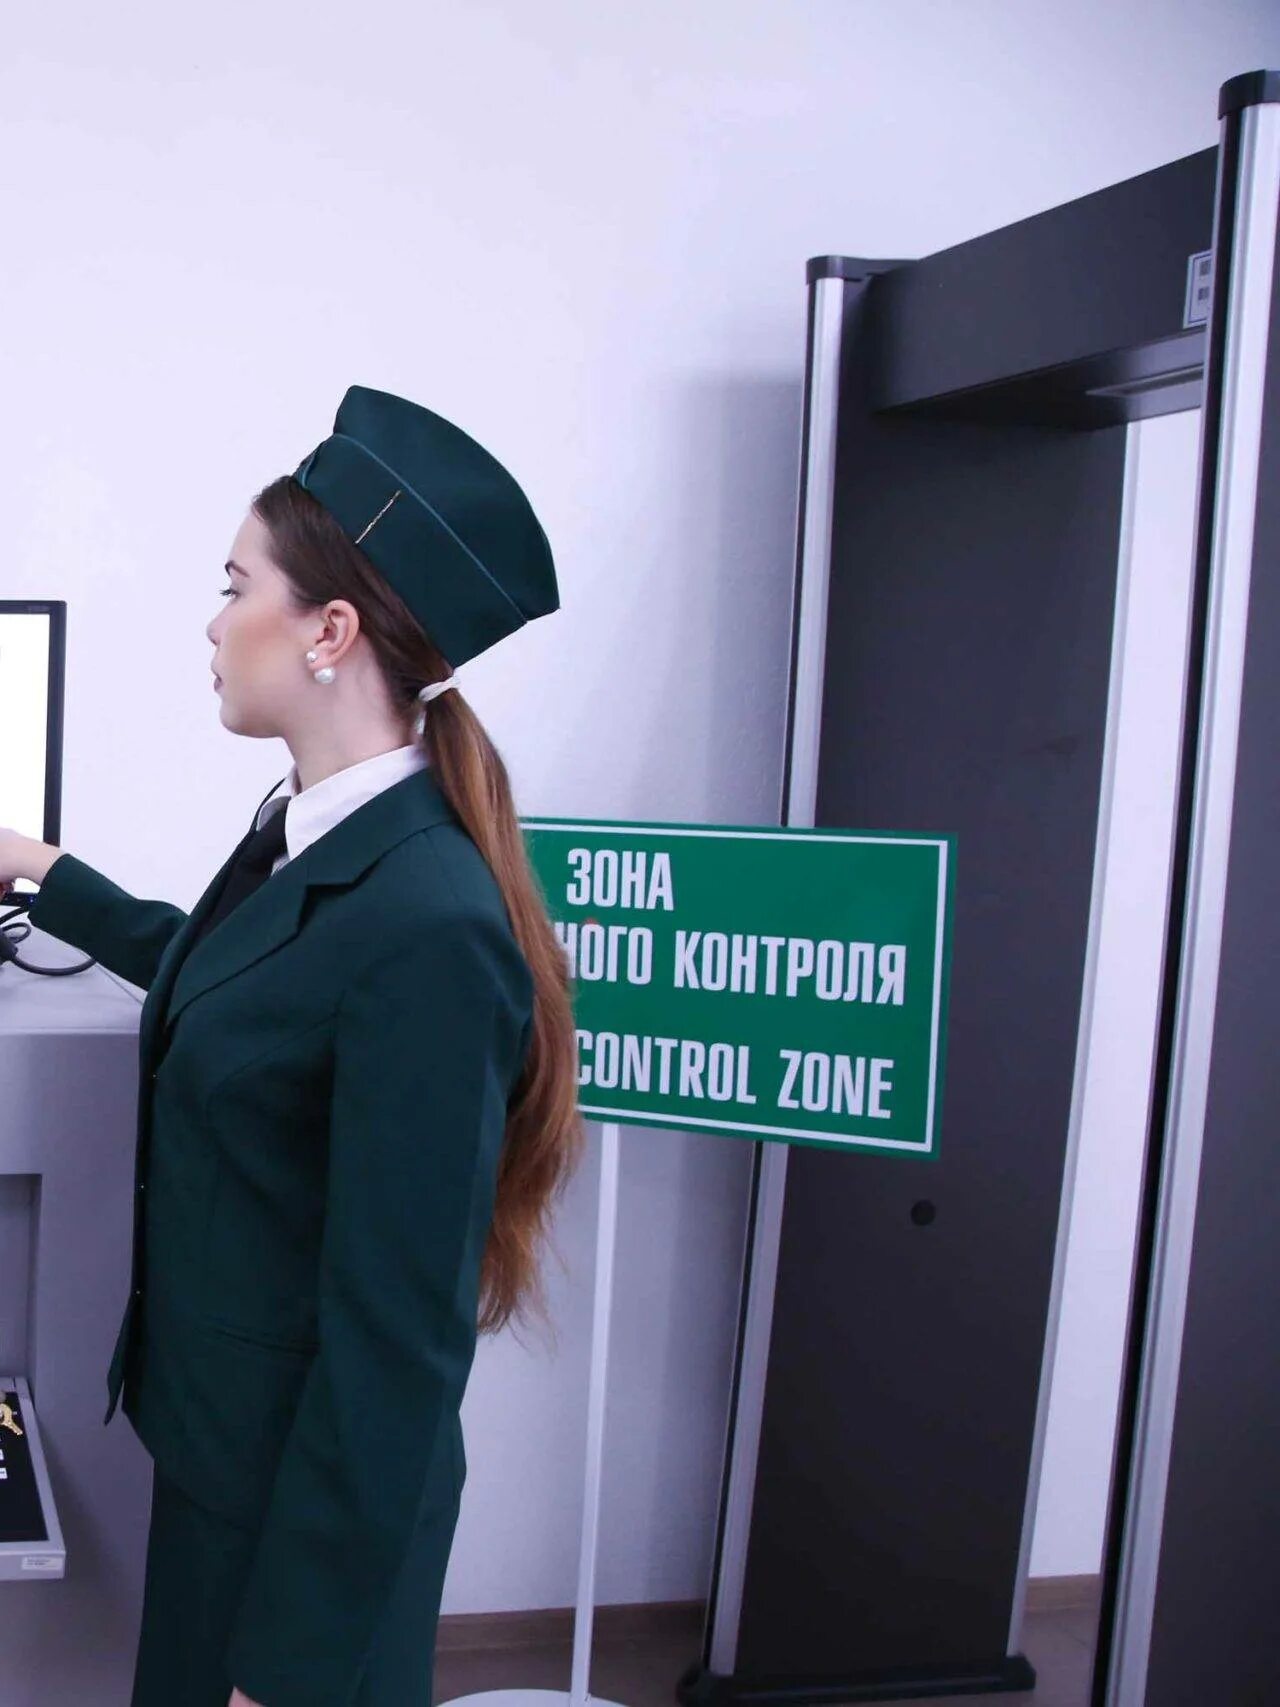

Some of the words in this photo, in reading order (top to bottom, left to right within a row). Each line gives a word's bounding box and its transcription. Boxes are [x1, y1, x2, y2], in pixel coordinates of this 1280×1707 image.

[566, 848, 674, 911] ЗОНА
[554, 922, 653, 986] НОГО
[673, 929, 907, 1006] КОНТРОЛЯ
[575, 1029, 757, 1105] CONTROL
[777, 1049, 895, 1119] ZONE
